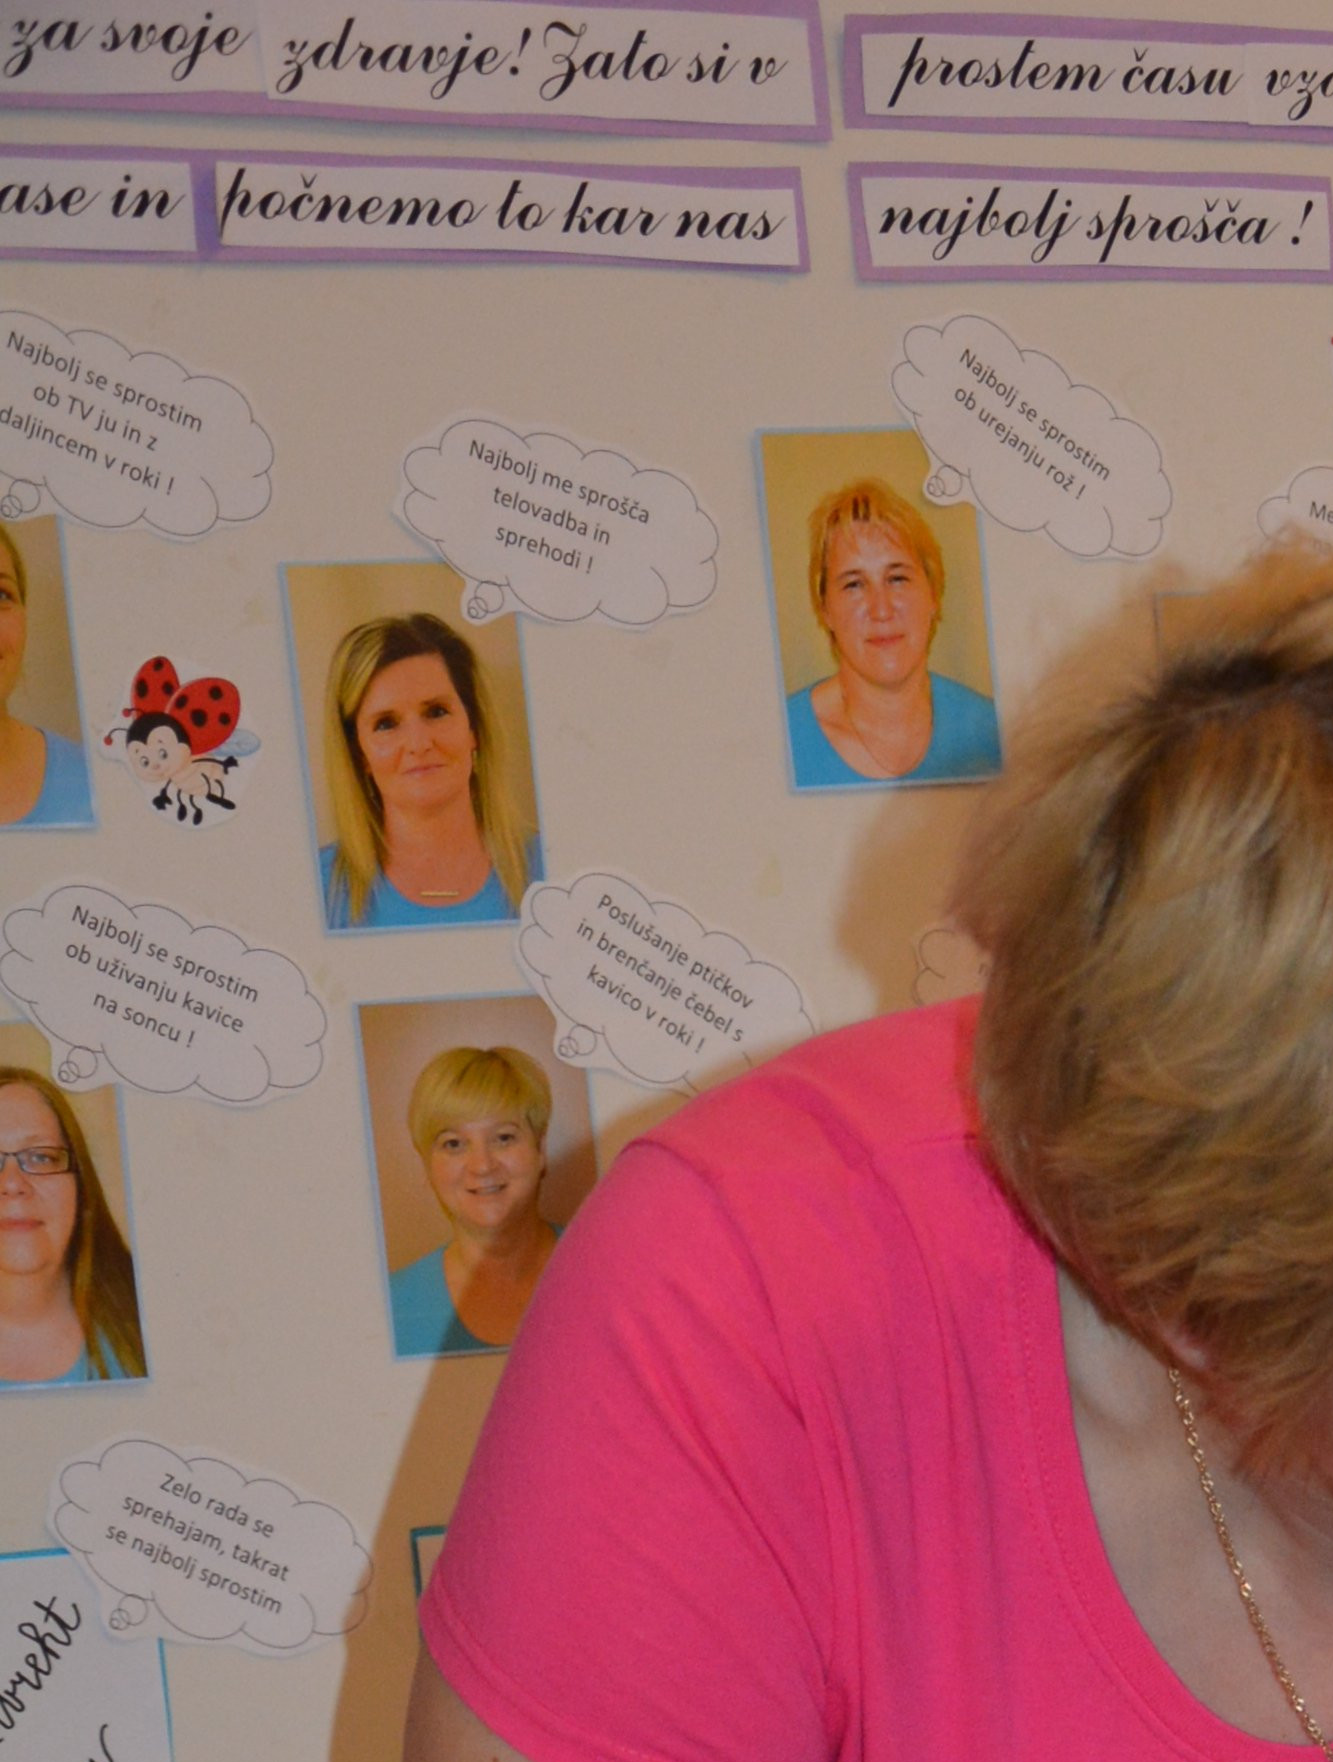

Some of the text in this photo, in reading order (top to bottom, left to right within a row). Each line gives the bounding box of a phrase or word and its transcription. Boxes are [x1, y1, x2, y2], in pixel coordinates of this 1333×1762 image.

[3, 17, 95, 78] za
[100, 12, 254, 82] svoje
[276, 17, 533, 100] zdravje!
[538, 20, 680, 101] Zato
[685, 41, 742, 84] si
[749, 56, 789, 84] v
[887, 37, 1115, 108] prostem
[1122, 47, 1243, 96] času
[110, 174, 186, 220] in
[218, 167, 489, 243] počnemo
[496, 178, 556, 232] to
[561, 181, 670, 237] kar
[673, 206, 788, 241] nas
[878, 186, 1082, 265] najbolj
[1086, 194, 1282, 265] sprošča
[1289, 199, 1315, 247] !
[7, 331, 203, 433] Najbolj se sprostim
[33, 385, 159, 452] ob TV ju in z
[959, 348, 1111, 481] Najbolj se sprostim
[0, 406, 175, 496] daljincem v roki !
[469, 439, 650, 524] Najbolj me sprošča
[954, 386, 1086, 500] ob urejanju rož !
[493, 487, 611, 545] telovadba in
[495, 525, 594, 575] sprehodi !
[65, 943, 244, 1033] ob uživanju kavice
[71, 905, 259, 1003] Najbolj se sprostim
[576, 918, 744, 1042] in brenčanje čebel s
[597, 894, 754, 1009] Poslušanje ptičkov
[93, 993, 196, 1048] na soncu !
[587, 964, 706, 1053] kavico v roki !
[122, 1496, 290, 1582] sprehajam, takrat
[160, 1473, 274, 1538] Zelo rada se
[105, 1525, 283, 1614] se najbolj sprostim
